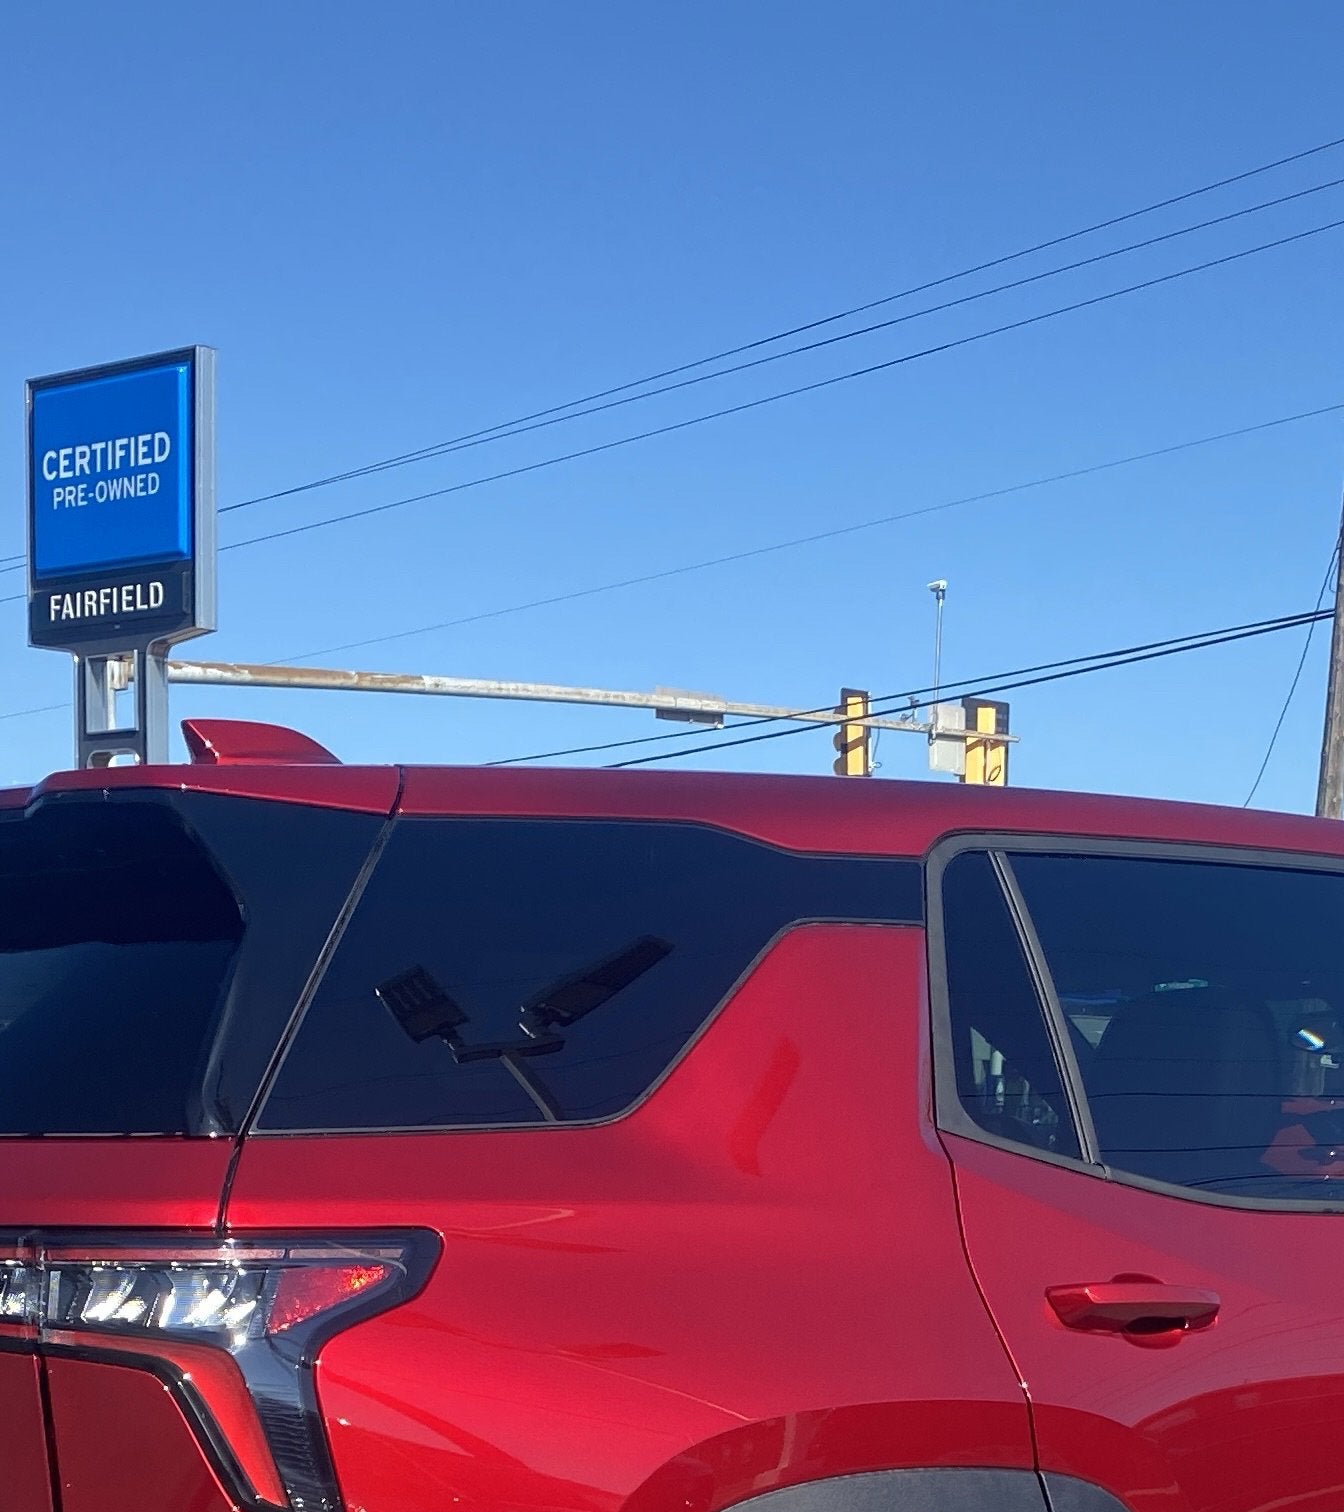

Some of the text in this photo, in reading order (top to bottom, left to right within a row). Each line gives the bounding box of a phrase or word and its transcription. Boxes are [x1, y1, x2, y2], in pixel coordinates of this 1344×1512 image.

[42, 431, 171, 481] CERTIFIED
[52, 472, 160, 510] PRE-OWNED
[49, 581, 164, 622] FAIRFIELD
